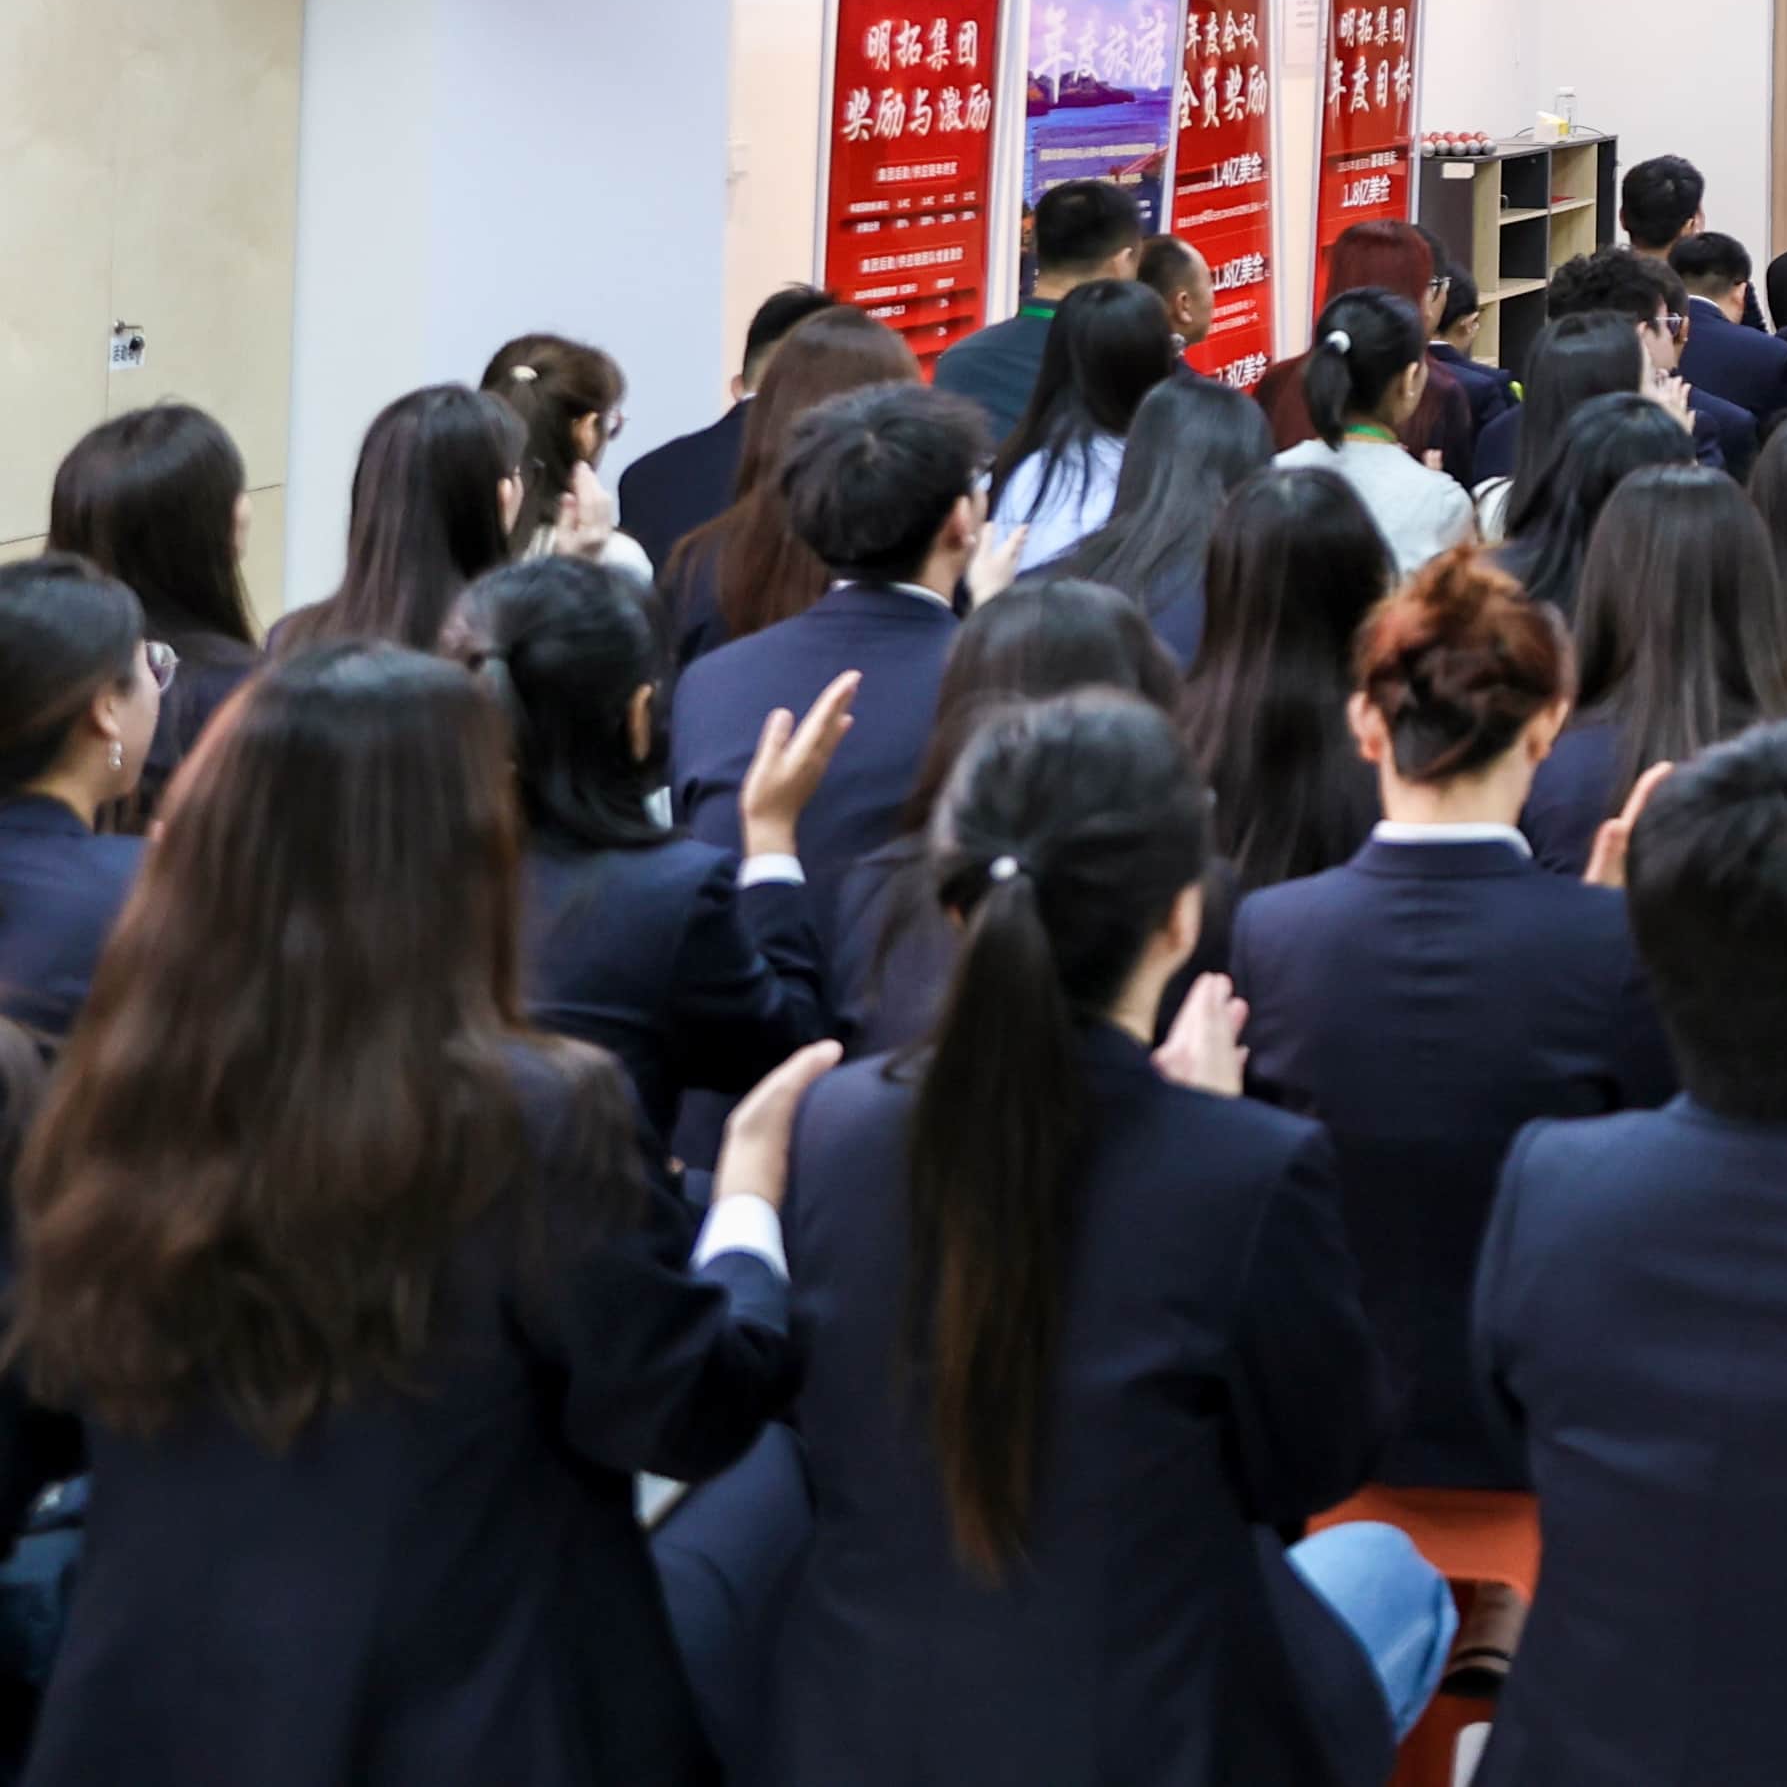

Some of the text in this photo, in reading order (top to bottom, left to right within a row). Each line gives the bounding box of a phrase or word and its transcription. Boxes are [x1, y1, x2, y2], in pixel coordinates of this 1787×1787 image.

[864, 17, 978, 71] 明拓集团
[1340, 6, 1406, 47] 明拓集团
